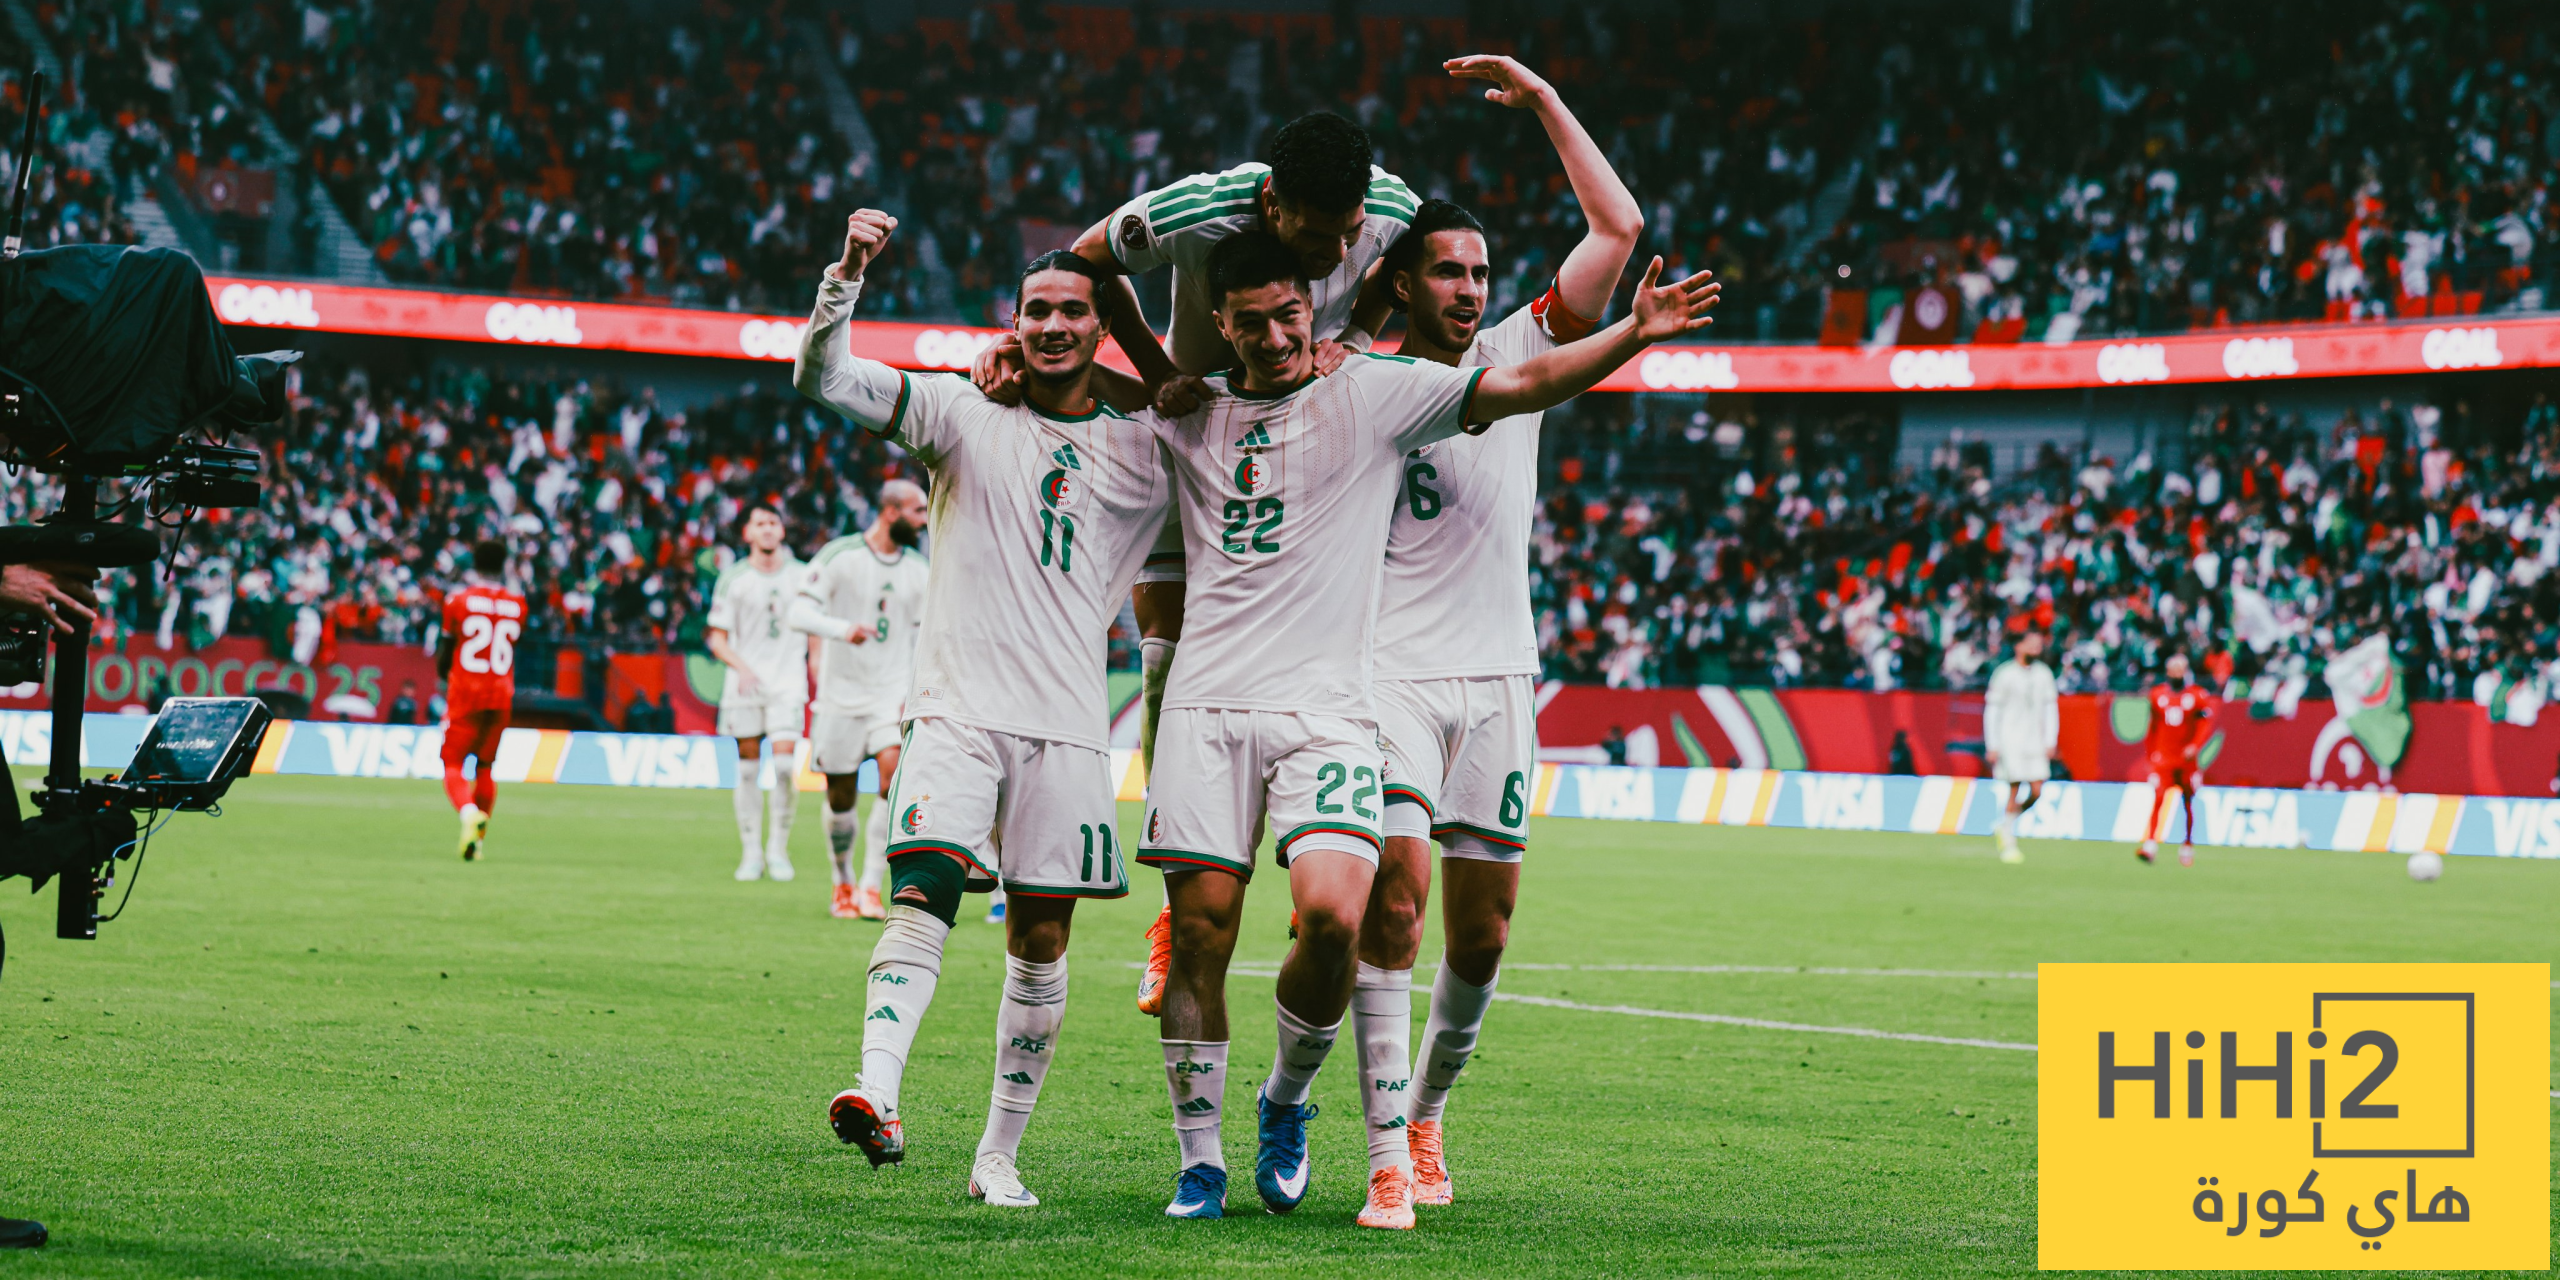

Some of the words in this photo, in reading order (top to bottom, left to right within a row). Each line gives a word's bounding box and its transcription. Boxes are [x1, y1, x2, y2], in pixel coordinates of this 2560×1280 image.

[219, 283, 319, 327] GOAL
[485, 302, 583, 344] GOAL
[739, 319, 808, 359] GO
[2222, 337, 2298, 378] GOAL
[2422, 327, 2503, 369] GOAL
[1640, 351, 1739, 389] GOAL
[1889, 350, 1975, 388] GOAL
[2097, 343, 2170, 383] GOAL
[1407, 463, 1442, 521] 6
[1040, 509, 1074, 572] 11
[1222, 497, 1285, 554] 22
[460, 615, 520, 676] 26
[596, 735, 720, 788] VISA
[1316, 762, 1377, 821] 22
[1499, 771, 1524, 828] 6
[1574, 769, 1655, 820] VISA
[1797, 774, 1884, 831] VISA
[2201, 787, 2301, 848] VISA
[1080, 823, 1112, 882] 11
[872, 973, 909, 986] FAF
[1010, 1037, 1047, 1054] FAF
[1175, 1062, 1214, 1074] FAF
[1376, 1079, 1409, 1092] FAF
